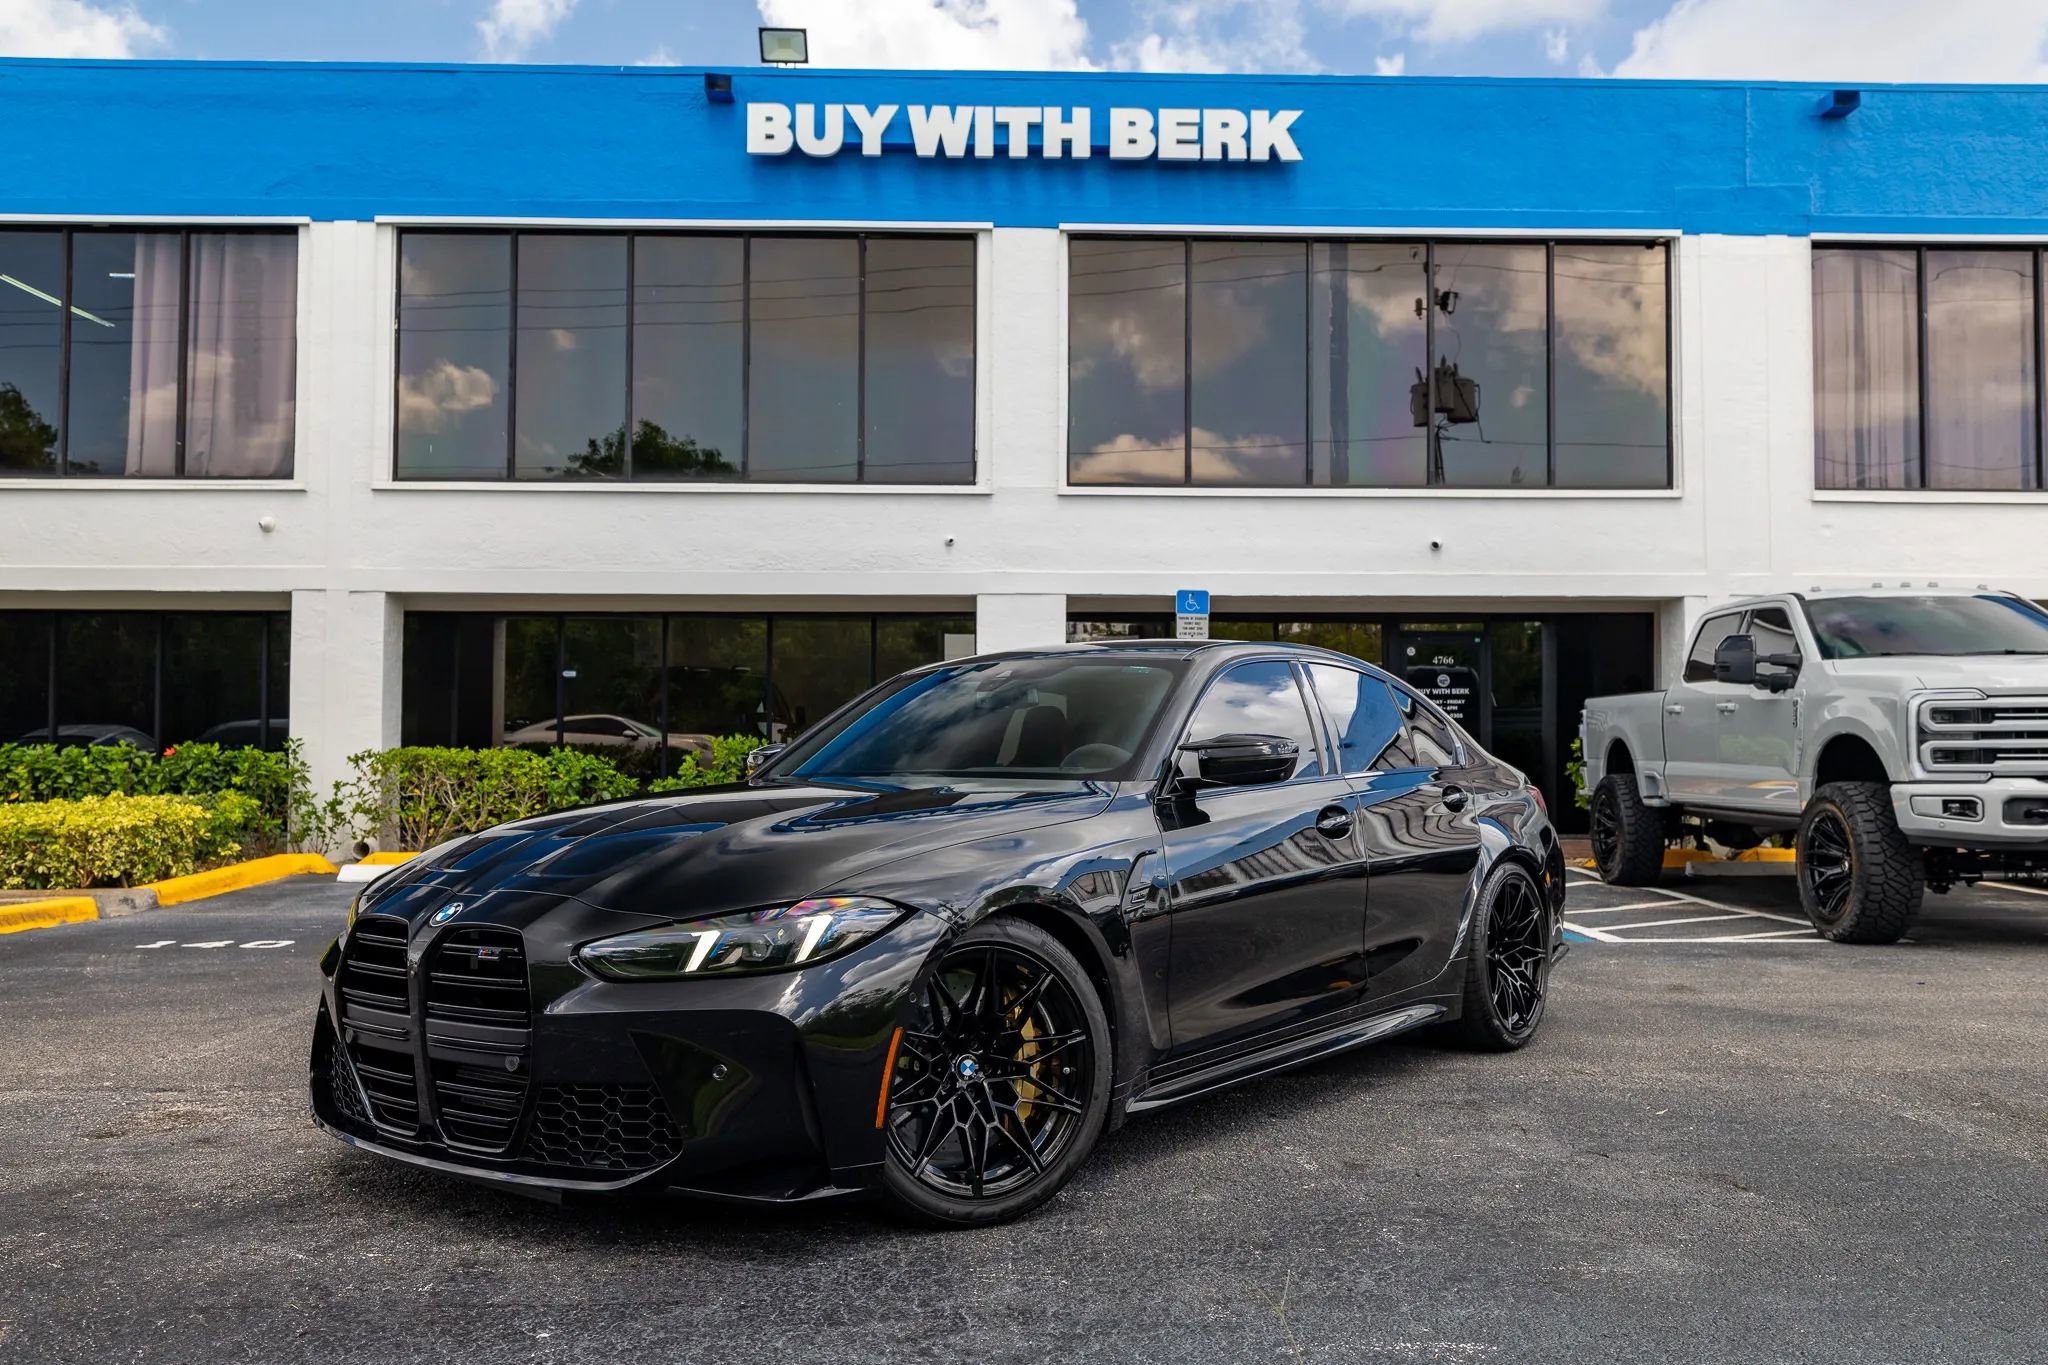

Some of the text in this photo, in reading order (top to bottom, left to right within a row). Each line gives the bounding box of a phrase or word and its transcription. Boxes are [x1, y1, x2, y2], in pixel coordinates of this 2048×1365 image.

[747, 103, 1304, 162] BUY WITH BERK
[1432, 656, 1454, 664] 4766
